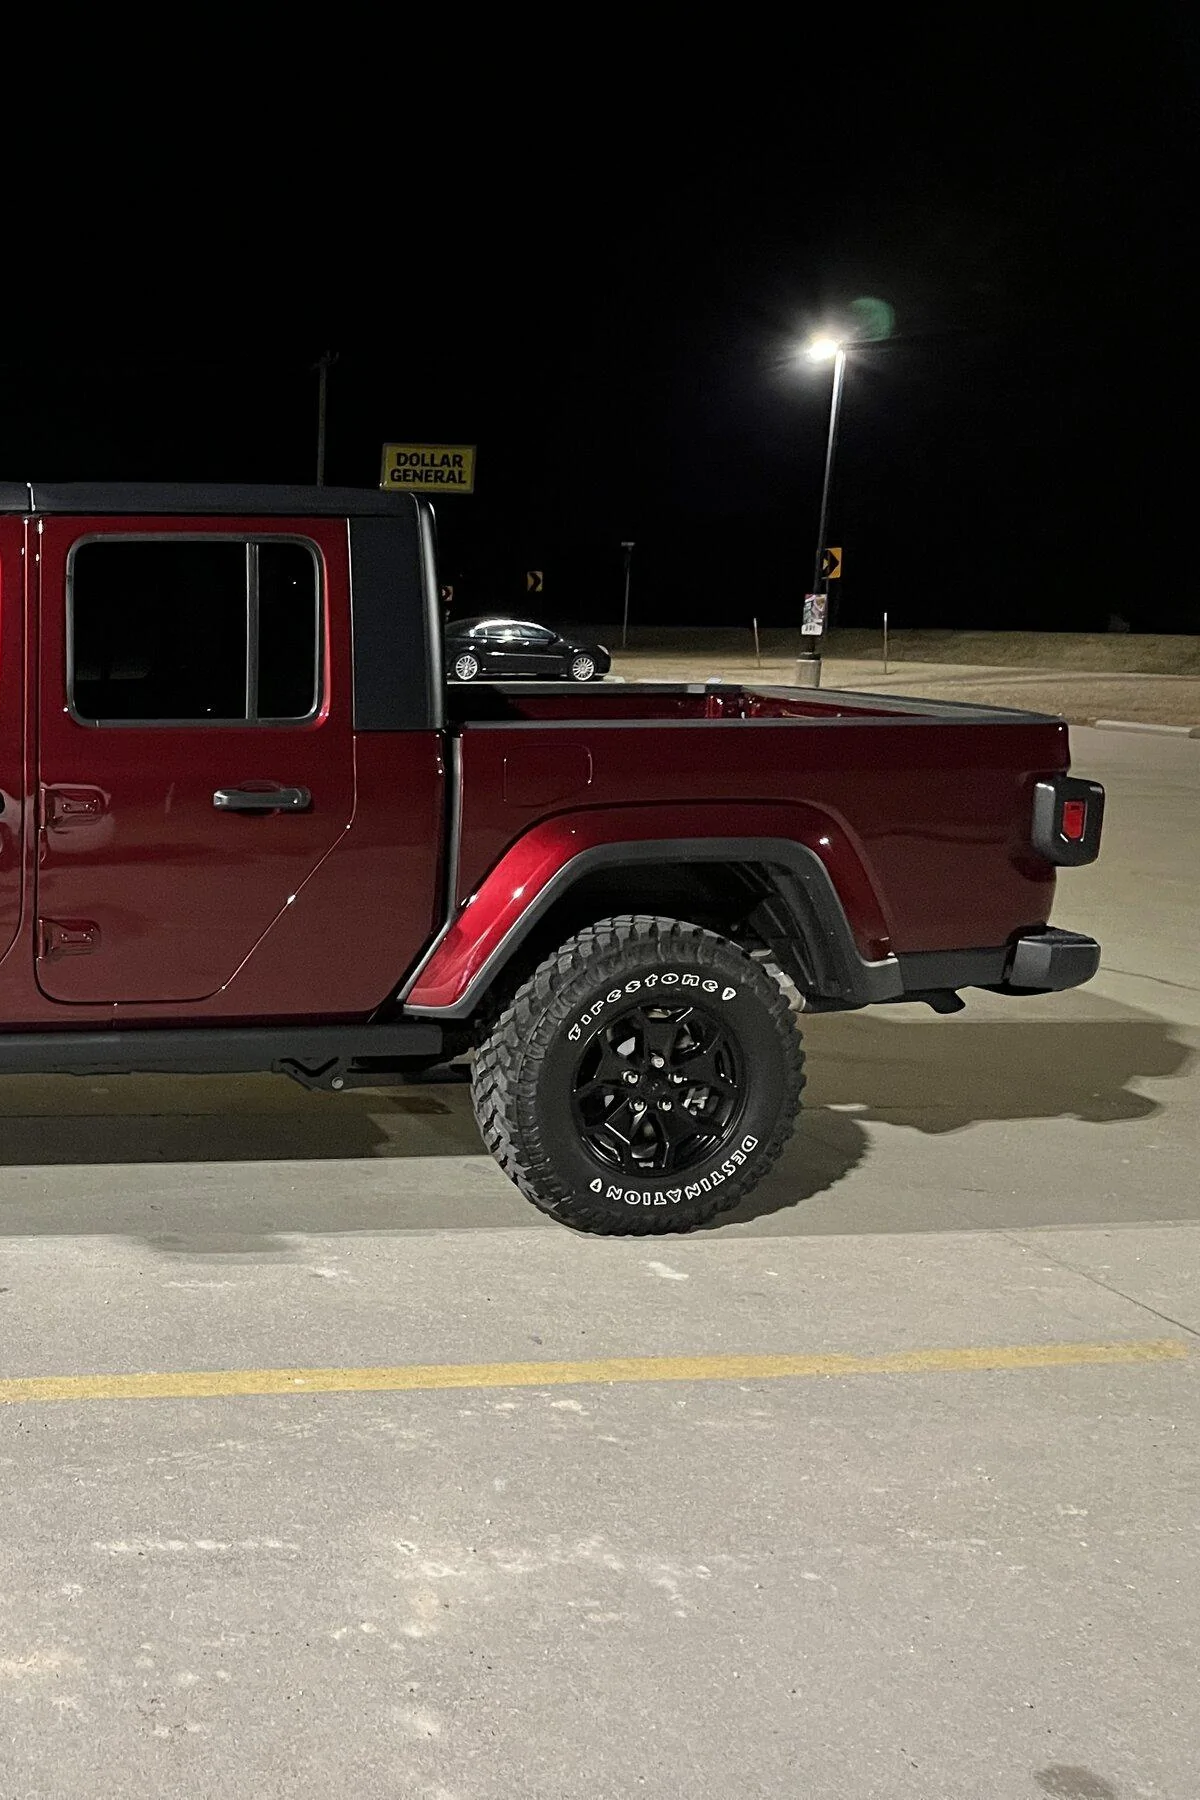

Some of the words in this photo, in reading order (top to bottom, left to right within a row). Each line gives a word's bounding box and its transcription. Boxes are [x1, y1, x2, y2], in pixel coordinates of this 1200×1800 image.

[390, 469, 466, 484] GENERAL
[396, 452, 463, 468] DOLLAR
[568, 972, 719, 1043] Firestone
[606, 1134, 759, 1206] DESTINATION
